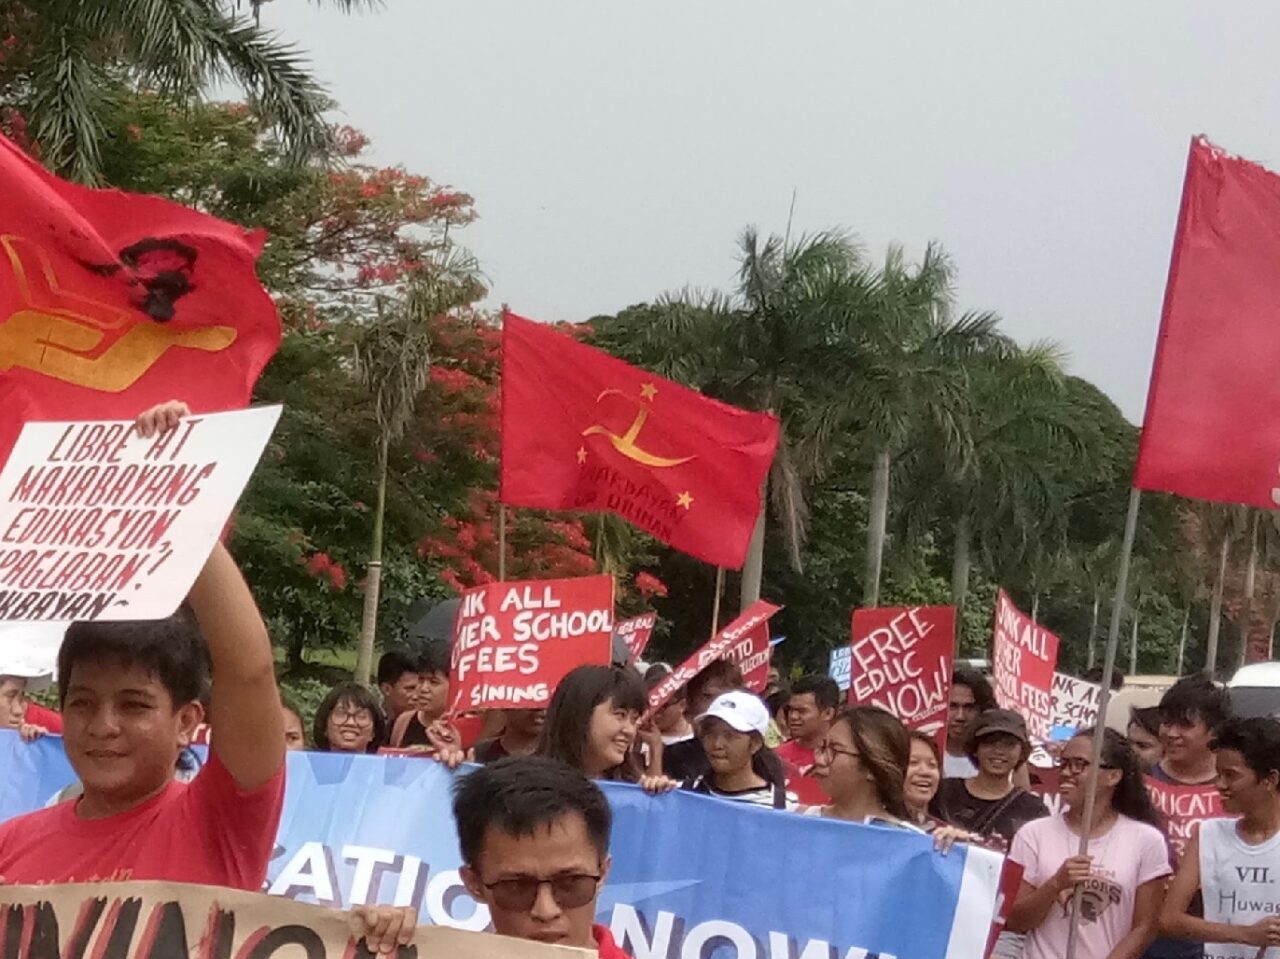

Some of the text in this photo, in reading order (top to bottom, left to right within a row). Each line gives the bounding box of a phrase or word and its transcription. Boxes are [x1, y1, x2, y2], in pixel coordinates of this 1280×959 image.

[47, 418, 204, 464] LIBRE AT
[8, 461, 218, 507] MAKABAYANG
[1, 507, 182, 552] EDUKASYON,
[500, 586, 561, 612] ALL
[513, 609, 612, 642] SCHOOL
[852, 606, 935, 673] FREE
[1021, 624, 1049, 661] ALL
[458, 643, 539, 682] FEES
[853, 651, 923, 701] EDUC
[470, 683, 549, 706] SINING
[1021, 681, 1050, 716] FEES
[1235, 866, 1276, 885] VII.
